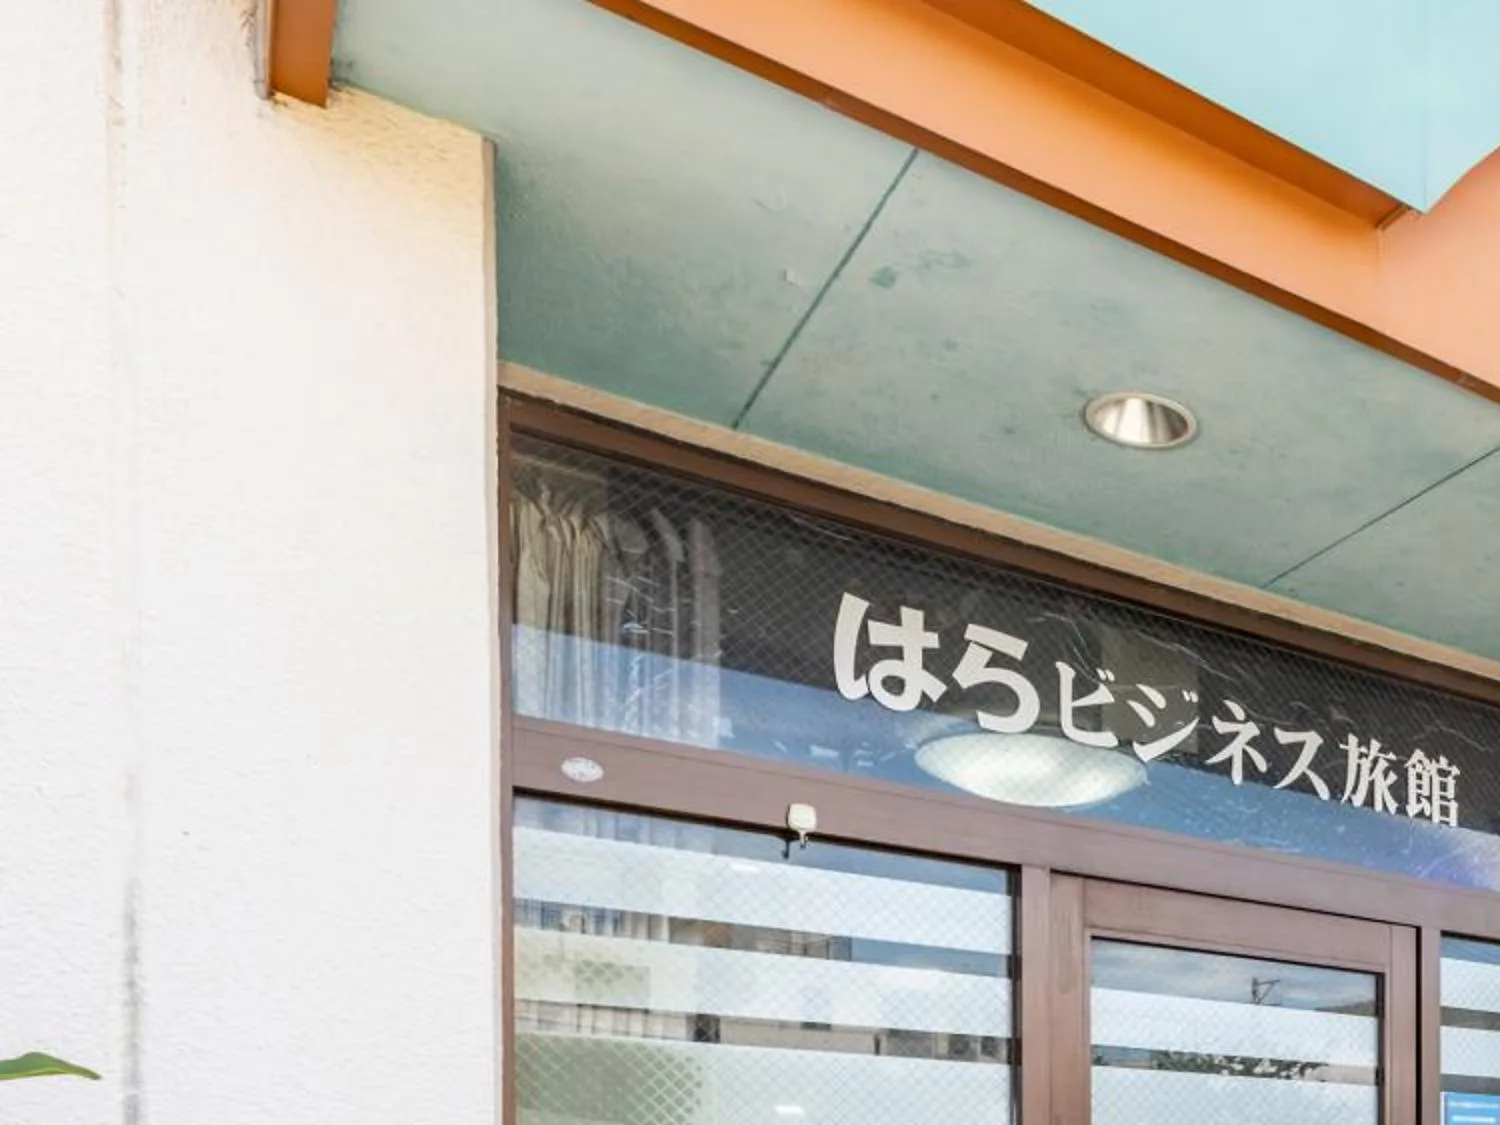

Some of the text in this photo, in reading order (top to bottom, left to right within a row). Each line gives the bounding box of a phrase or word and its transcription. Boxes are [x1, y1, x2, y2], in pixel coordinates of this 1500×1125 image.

[833, 592, 1461, 828] はらビジネス旅館
